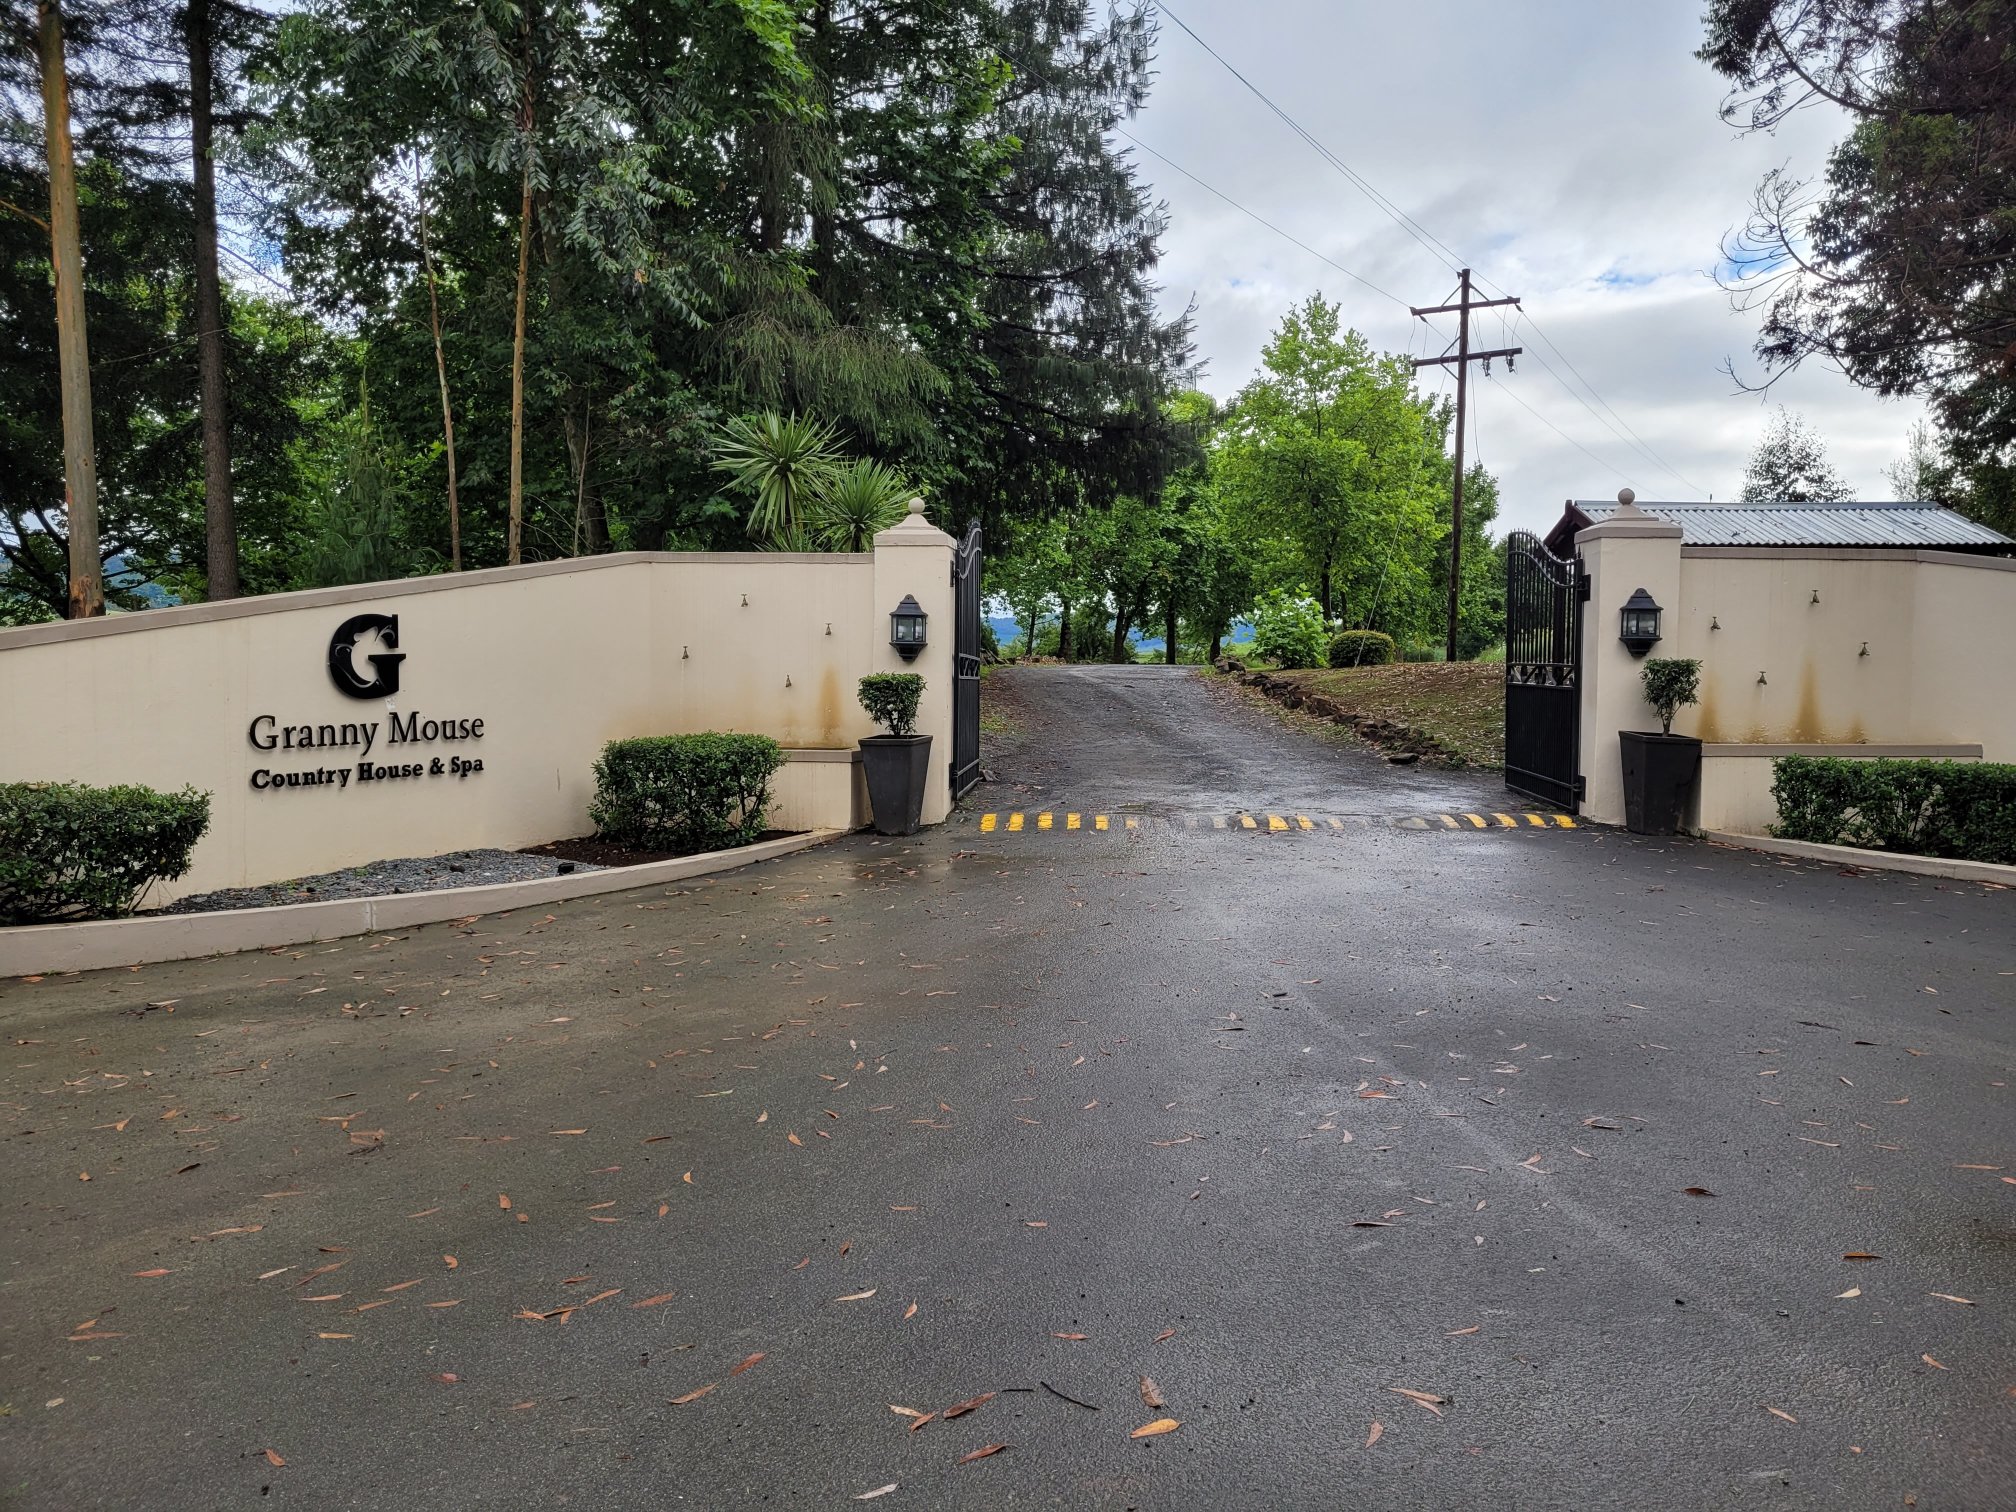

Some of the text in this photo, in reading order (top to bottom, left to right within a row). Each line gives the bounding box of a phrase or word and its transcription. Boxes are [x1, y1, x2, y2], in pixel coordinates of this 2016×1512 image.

[329, 613, 407, 700] G
[249, 711, 485, 757] Granny Mouse
[251, 756, 484, 790] Country House & Spa
